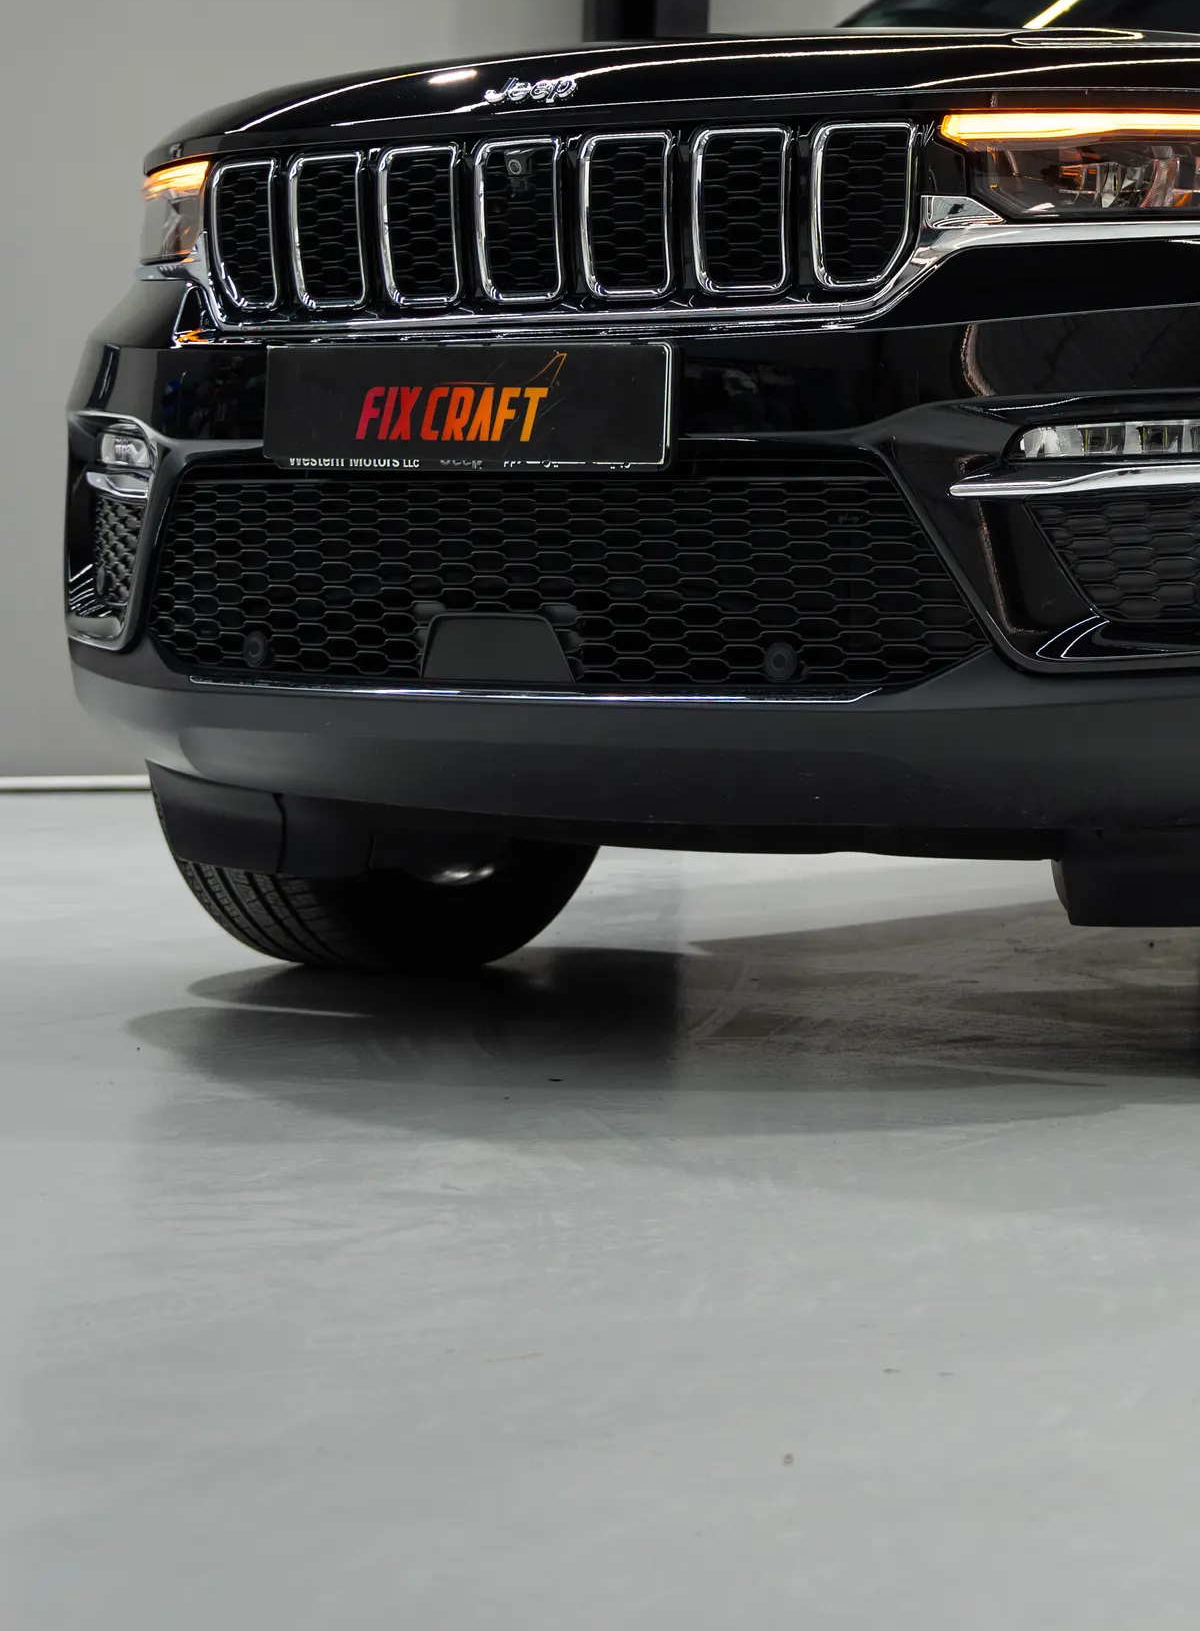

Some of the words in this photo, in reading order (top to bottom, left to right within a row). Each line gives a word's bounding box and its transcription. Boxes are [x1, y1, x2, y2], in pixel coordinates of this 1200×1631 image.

[484, 76, 577, 103] Jeep
[355, 386, 423, 441] FIX
[419, 386, 549, 442] CRAFT
